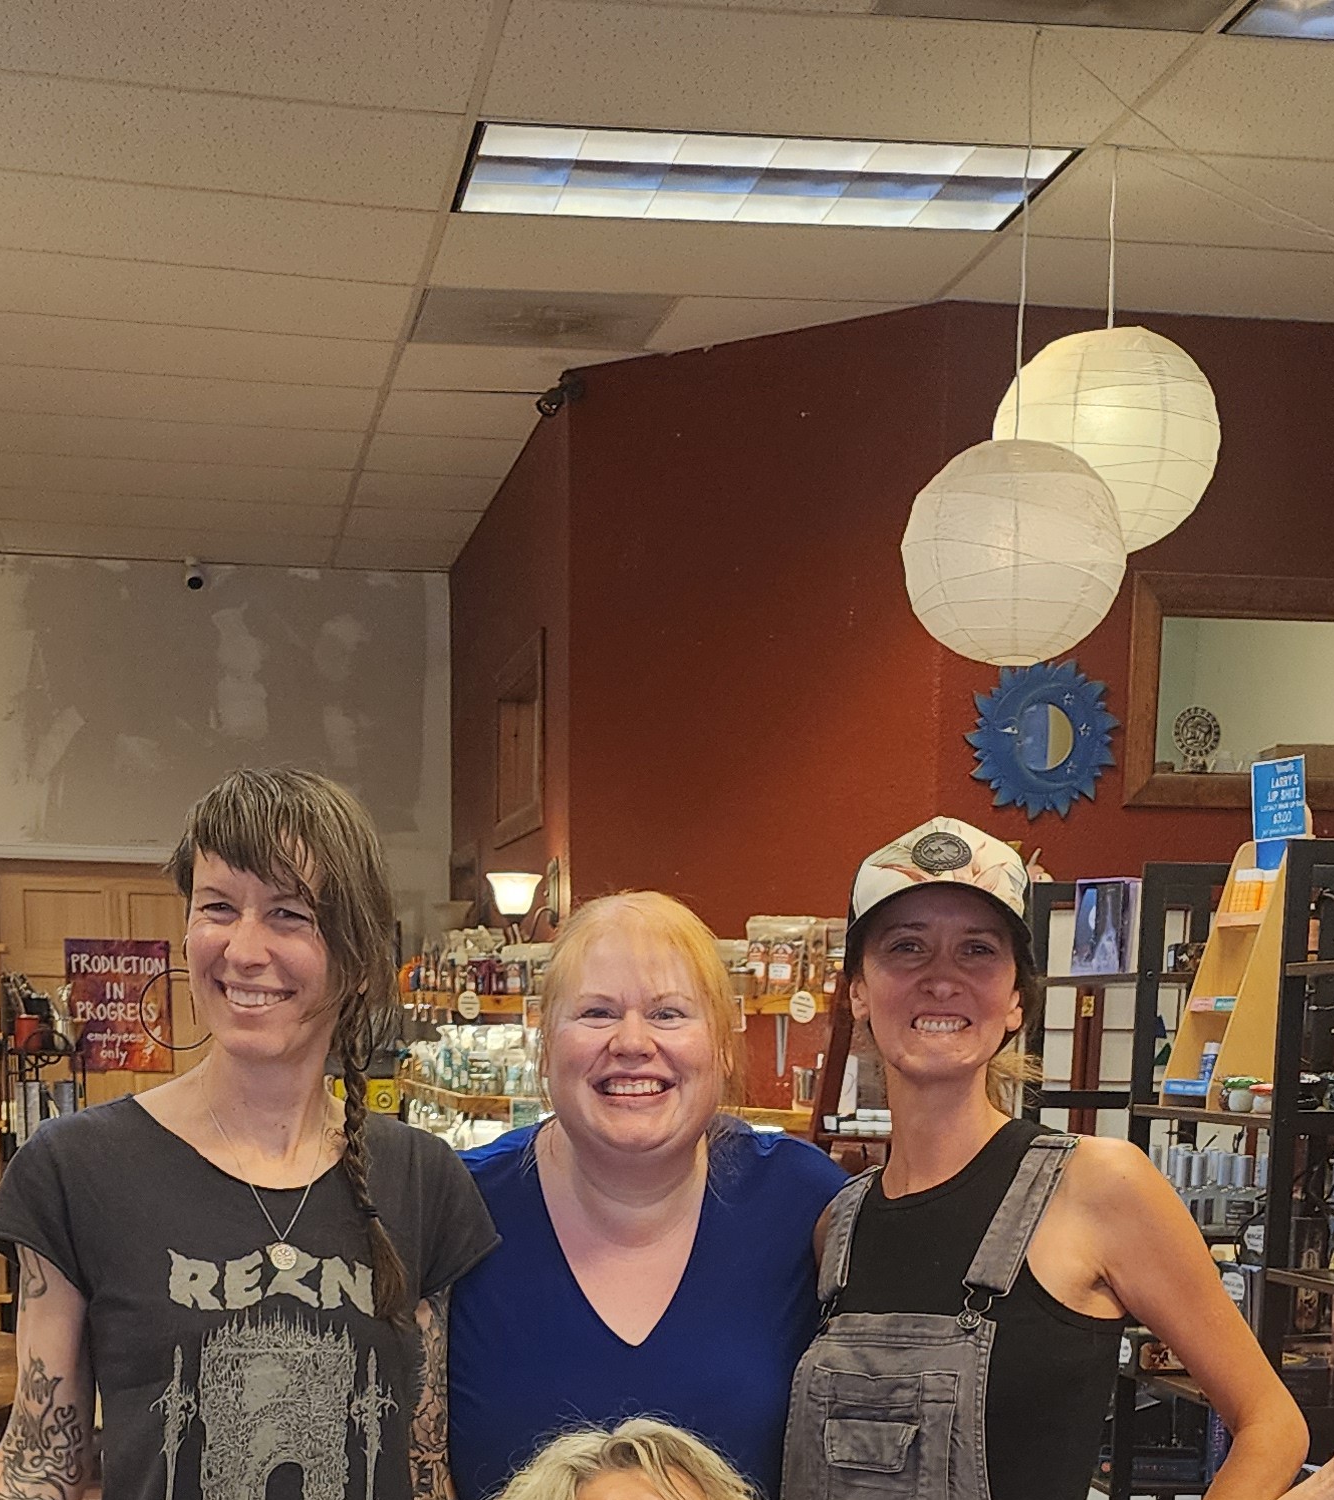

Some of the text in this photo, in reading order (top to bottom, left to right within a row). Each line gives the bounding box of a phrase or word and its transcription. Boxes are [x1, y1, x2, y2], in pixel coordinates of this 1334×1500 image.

[70, 953, 166, 975] PRODUCTION
[105, 981, 125, 1000] IN
[86, 1029, 145, 1047] employees
[99, 1047, 128, 1067] only
